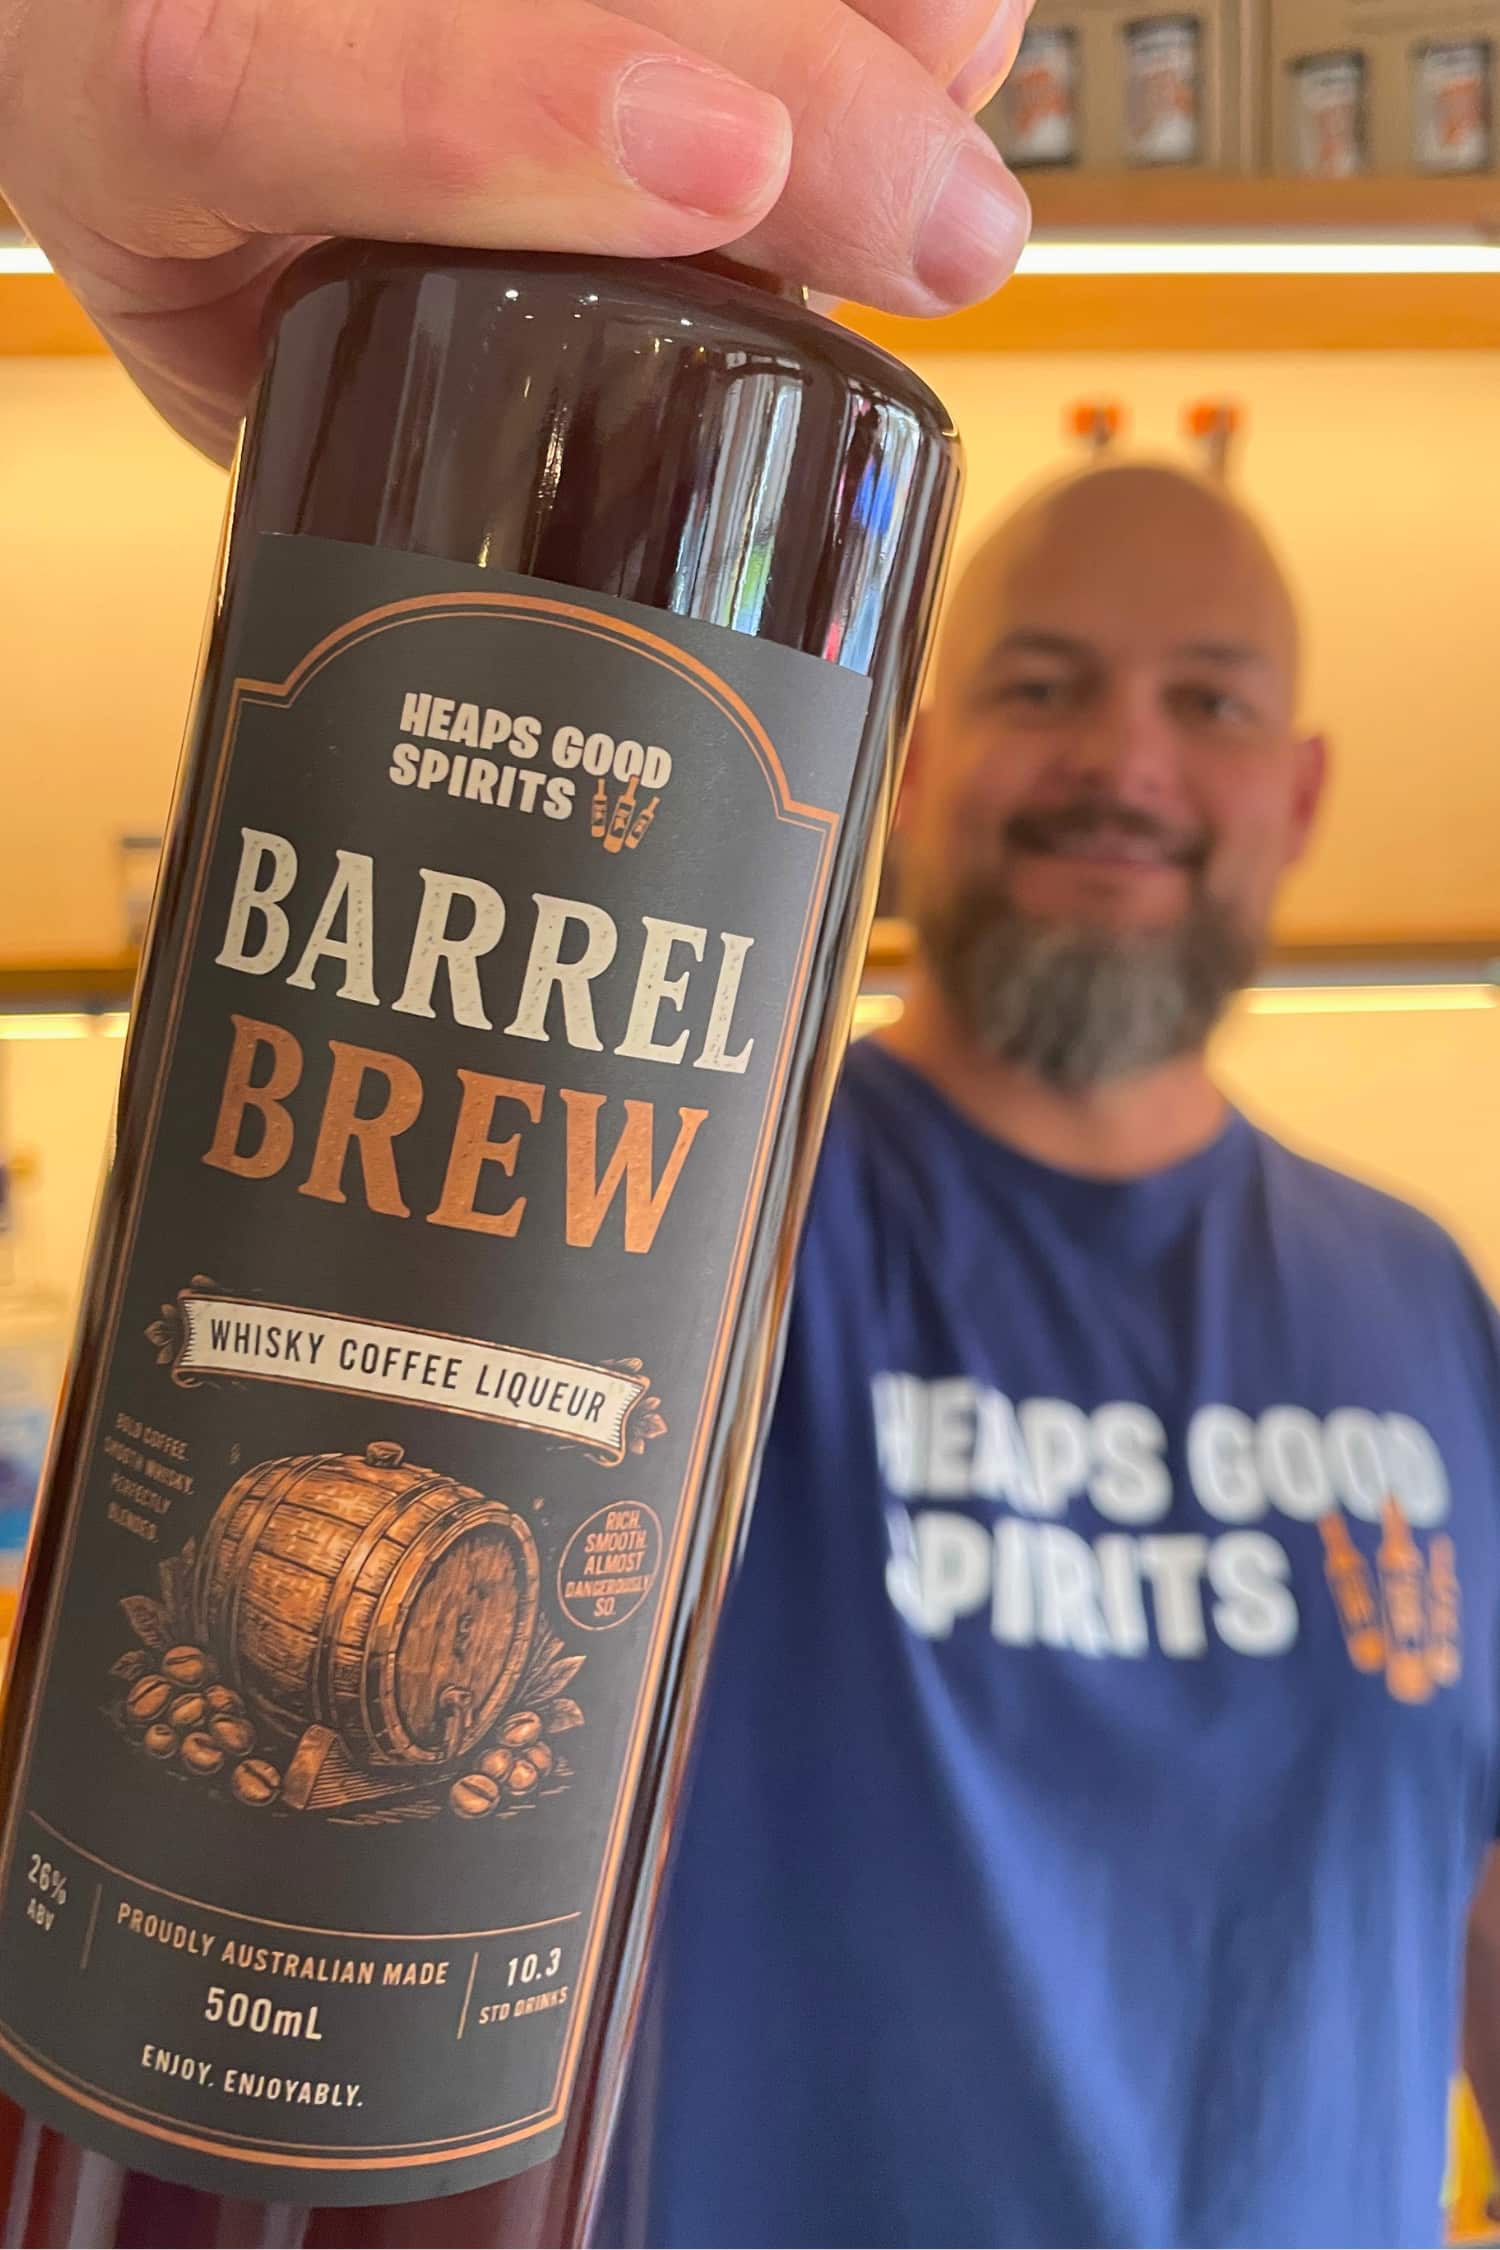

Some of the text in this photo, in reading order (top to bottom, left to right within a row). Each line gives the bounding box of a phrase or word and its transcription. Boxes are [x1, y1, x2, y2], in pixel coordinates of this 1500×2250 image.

[399, 692, 673, 790] HEAPS GOOD
[389, 743, 577, 821] SPIRITS
[214, 827, 756, 1074] BARREL
[201, 1013, 709, 1254] BREW
[209, 1318, 608, 1424] WHISKY COFFEE LIQUEUR
[1186, 1403, 1451, 1530] GOOD
[583, 1551, 647, 1575] ALMOST
[26, 1897, 55, 1931] ABV
[28, 1853, 68, 1905] 26%
[117, 1902, 450, 1986] PROUDLY AUSTRALIAN MADE
[507, 1947, 562, 1987] 10.3
[204, 1986, 323, 2041] 500mL
[478, 1985, 569, 2025] STD DRINKS
[141, 2044, 364, 2108] ENJOY. ENJOYABLY.
